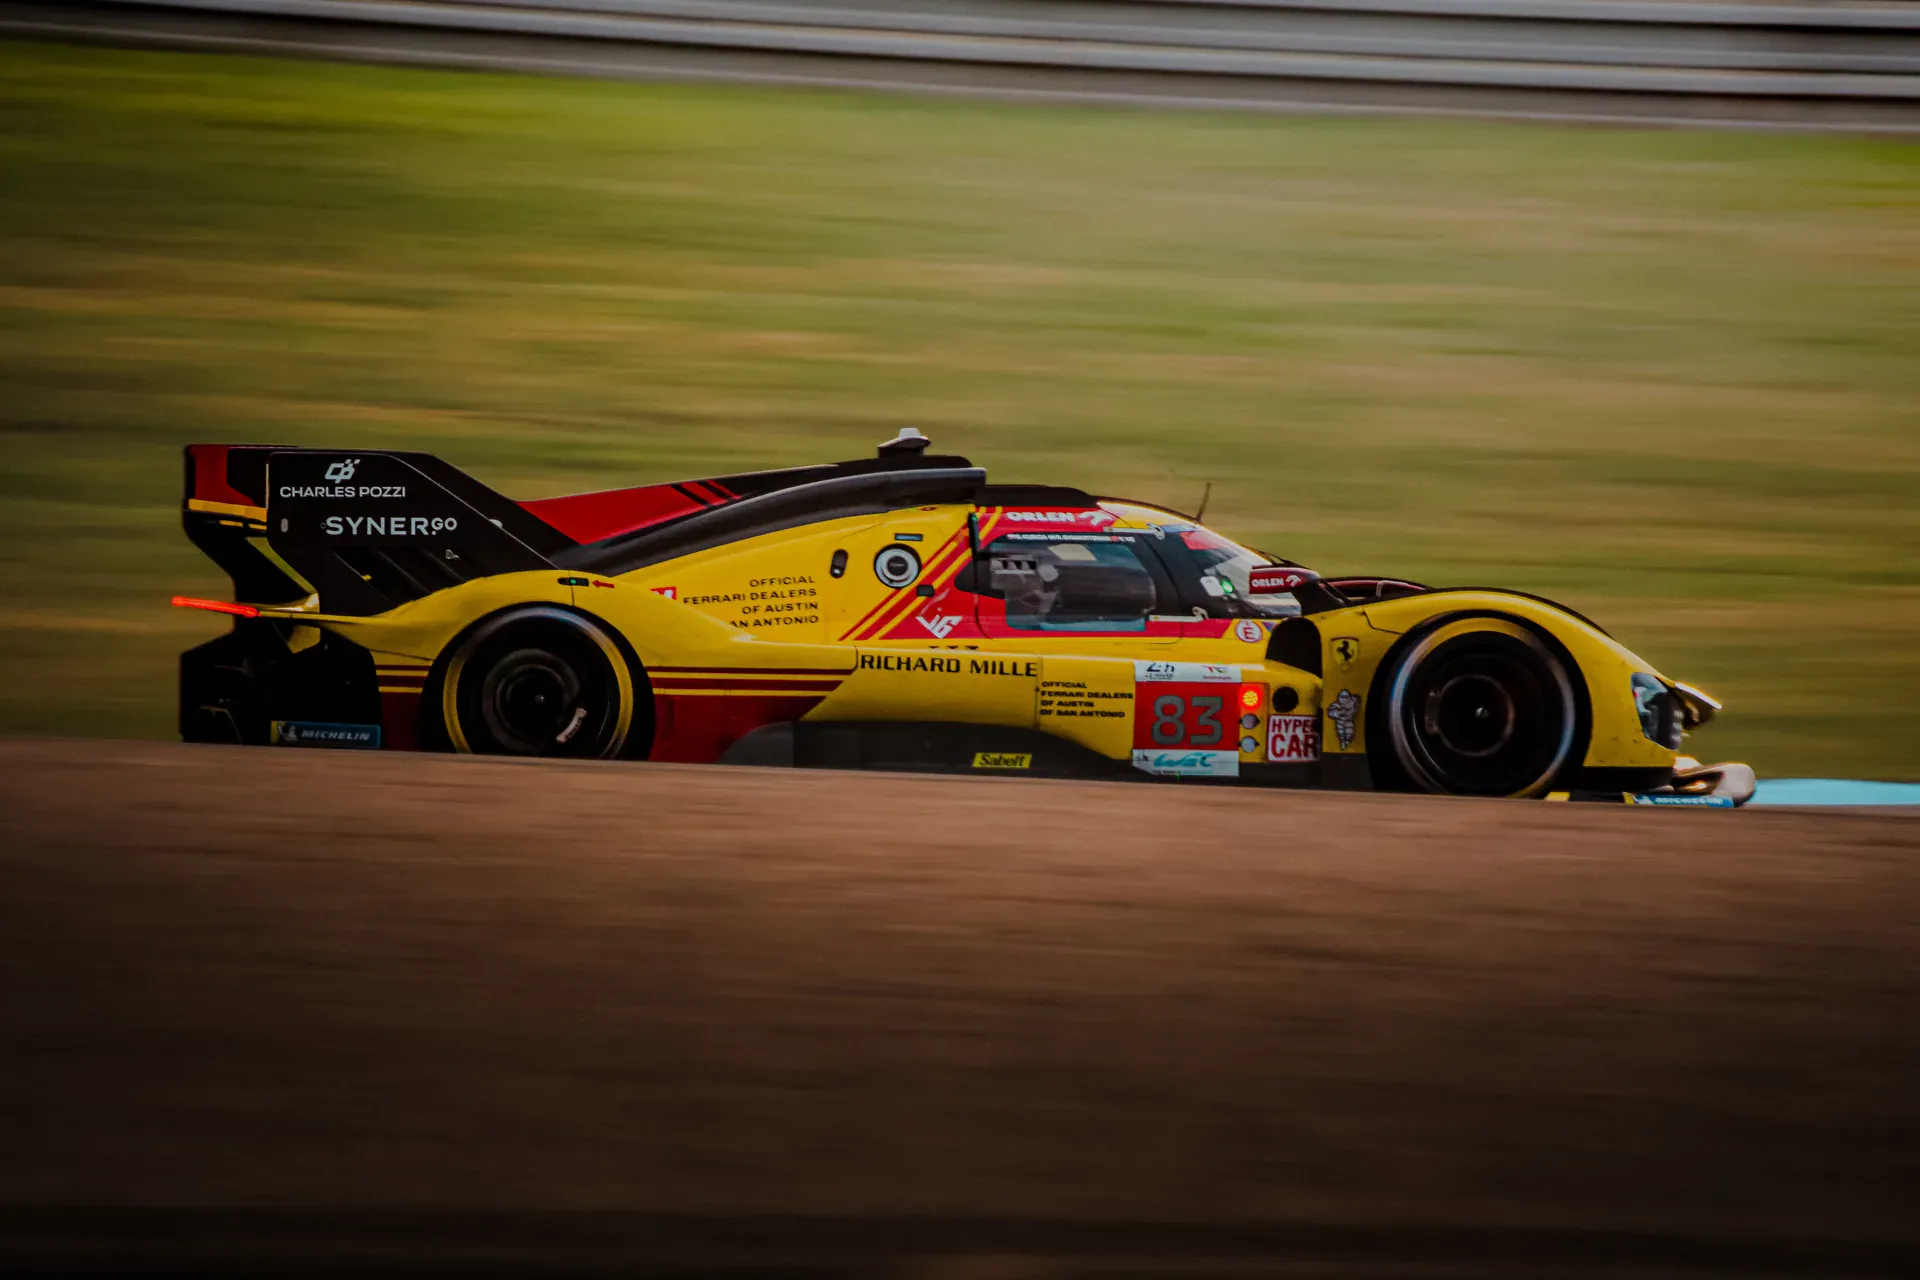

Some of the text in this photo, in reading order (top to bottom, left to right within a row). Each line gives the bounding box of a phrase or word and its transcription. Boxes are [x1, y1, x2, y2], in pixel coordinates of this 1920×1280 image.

[280, 486, 406, 498] CHARLES POZZI
[1006, 511, 1075, 523] ORLEN
[749, 575, 815, 588] OFFICIAL
[1251, 577, 1284, 588] ORLEN
[683, 588, 817, 605] FERRARI DEALERS
[742, 602, 818, 615] OF AUSTIN
[753, 615, 819, 628] ANTONIO
[1243, 627, 1256, 640] E
[860, 654, 1037, 677] RICHARD MILLE
[1041, 681, 1088, 689] OFFICIAL
[1041, 690, 1085, 698] FERRARI
[1056, 700, 1095, 708] AUSTIN
[1056, 709, 1078, 717] SAN
[1079, 710, 1126, 718] ANTONIO
[1152, 694, 1223, 745] 83
[301, 729, 371, 741] MICHELIN
[1271, 734, 1319, 758] CAR
